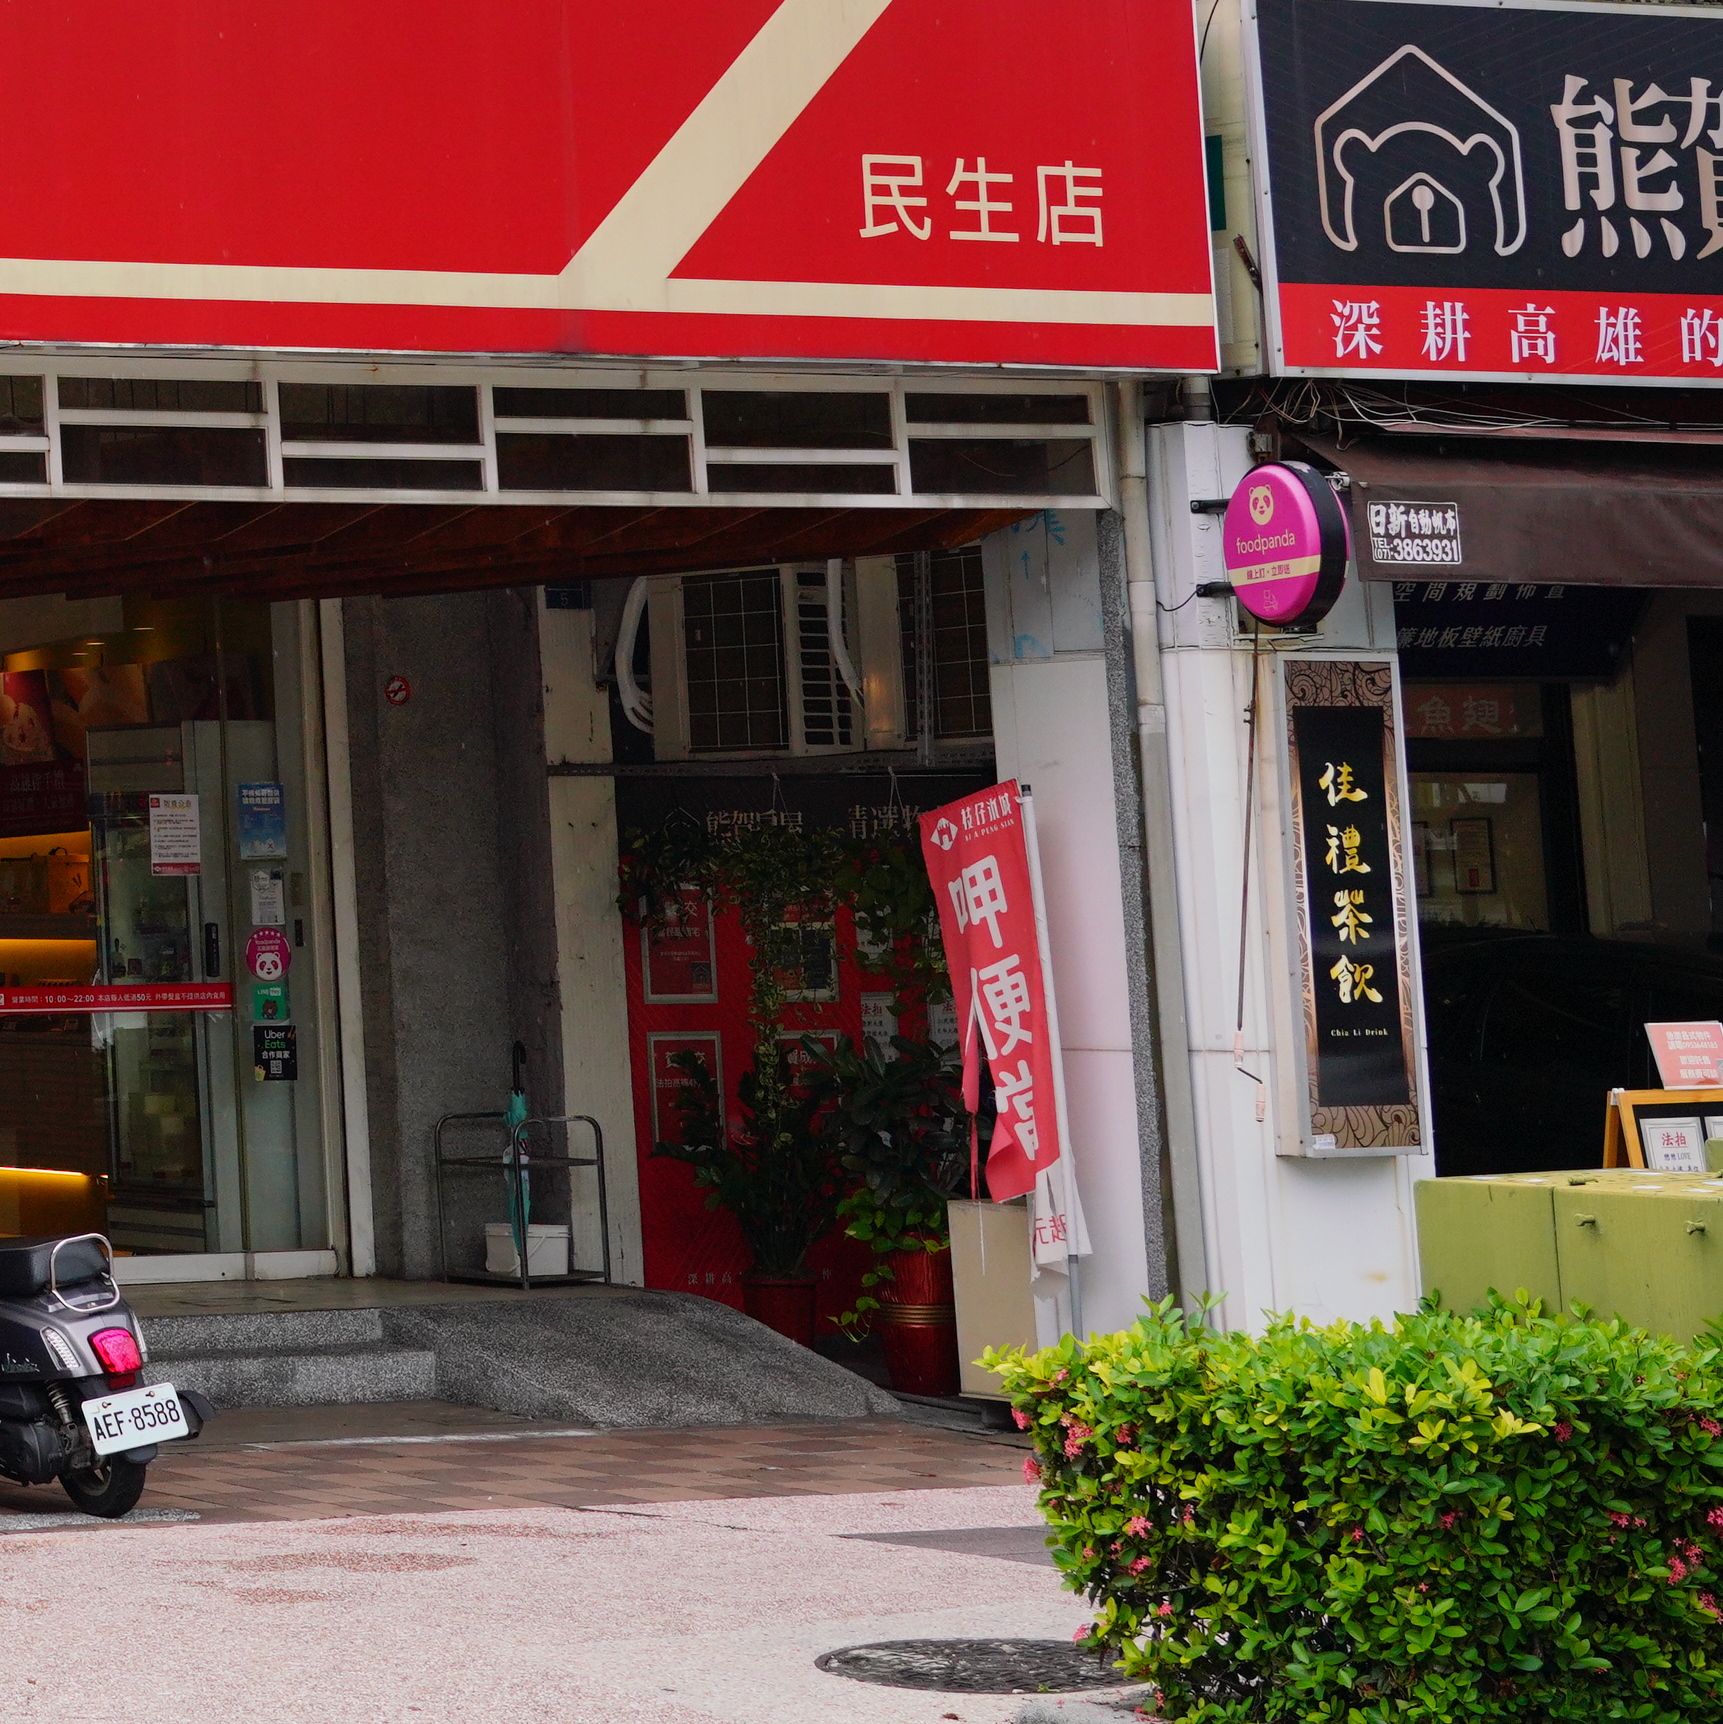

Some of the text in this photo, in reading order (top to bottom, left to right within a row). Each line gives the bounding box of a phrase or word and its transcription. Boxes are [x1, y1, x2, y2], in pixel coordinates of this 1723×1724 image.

[859, 153, 1104, 247] 民生店
[1330, 298, 1723, 368] 深耕高雄的
[1370, 503, 1456, 538] 日新自動帆布
[1236, 529, 1296, 555] foodpanda
[1393, 538, 1459, 561] 3863931
[1318, 761, 1384, 1005] 佳禮茶飲
[264, 1029, 286, 1039] Uber
[1330, 1027, 1389, 1037] Chia Li Drink
[264, 1040, 286, 1049] Eats
[1661, 1132, 1687, 1146] 法拍
[1677, 1152, 1691, 1161] LOVE
